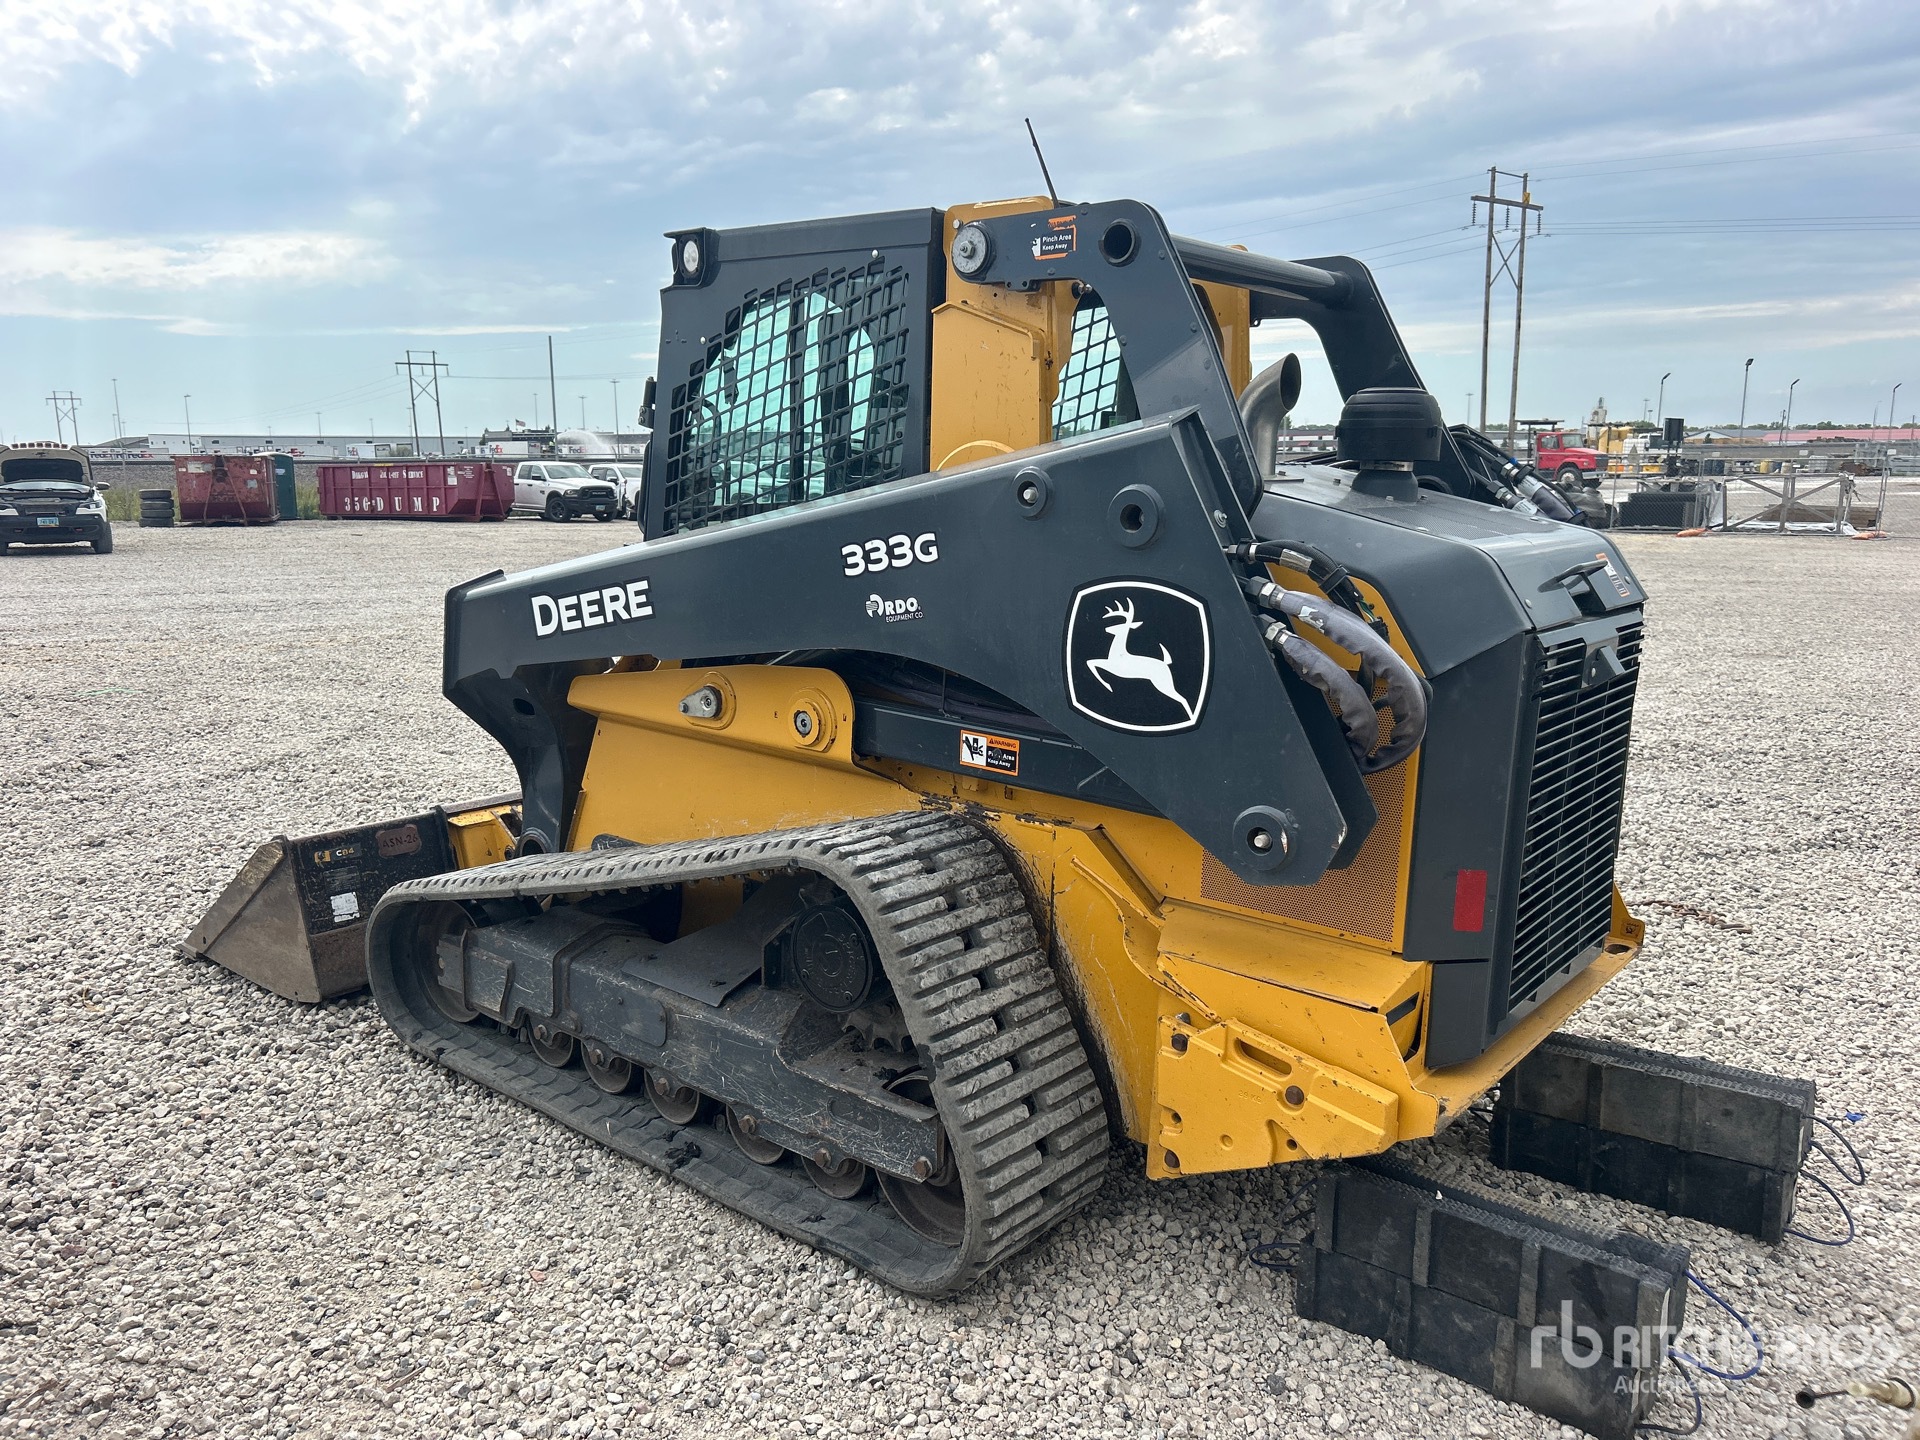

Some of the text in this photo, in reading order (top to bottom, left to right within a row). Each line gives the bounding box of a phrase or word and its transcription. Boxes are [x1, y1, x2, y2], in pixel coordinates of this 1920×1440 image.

[1042, 235, 1058, 243] Pinch
[841, 532, 939, 576] 333G
[531, 579, 653, 637] DEERE
[886, 613, 914, 622] EQUIPMENT
[993, 739, 1016, 748] WARNING
[1003, 753, 1014, 761] Area
[999, 760, 1010, 768] Away
